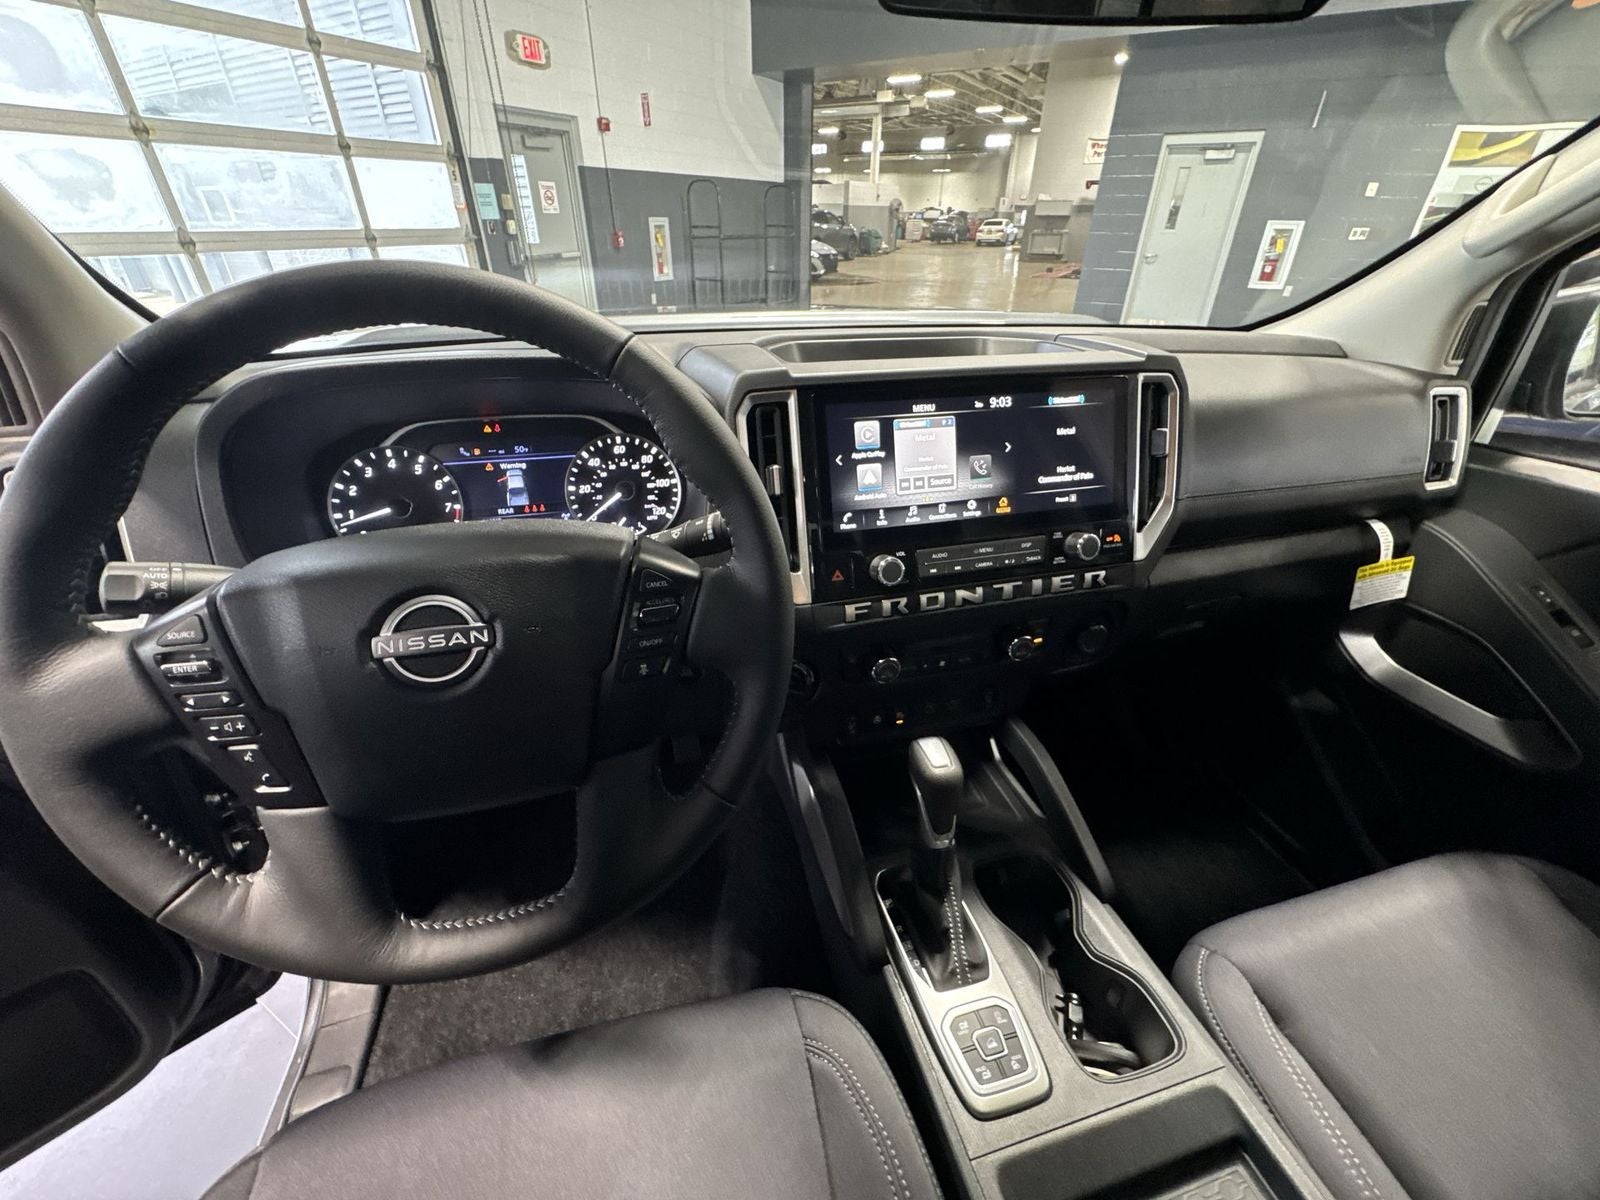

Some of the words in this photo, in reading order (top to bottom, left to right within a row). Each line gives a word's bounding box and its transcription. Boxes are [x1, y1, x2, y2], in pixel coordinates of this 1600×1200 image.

[522, 36, 542, 62] EXIT
[990, 396, 1012, 408] 9:03
[912, 404, 936, 412] MENU
[614, 445, 626, 454] 60
[388, 458, 396, 469] 4
[588, 458, 600, 466] 40
[641, 455, 653, 463] 80
[365, 467, 372, 477] 3
[414, 464, 422, 475] 5
[435, 480, 443, 490] 6
[656, 479, 670, 487] 100
[348, 486, 357, 496] 2
[579, 485, 591, 493] 20
[445, 502, 452, 512] 7
[652, 507, 666, 515] 120
[348, 509, 354, 519] 1
[646, 580, 668, 588] CANCEL
[844, 570, 1107, 622] FRONTIER
[167, 630, 196, 640] SOURCE
[378, 629, 489, 654] NISSAN
[172, 665, 198, 674] ENTER
